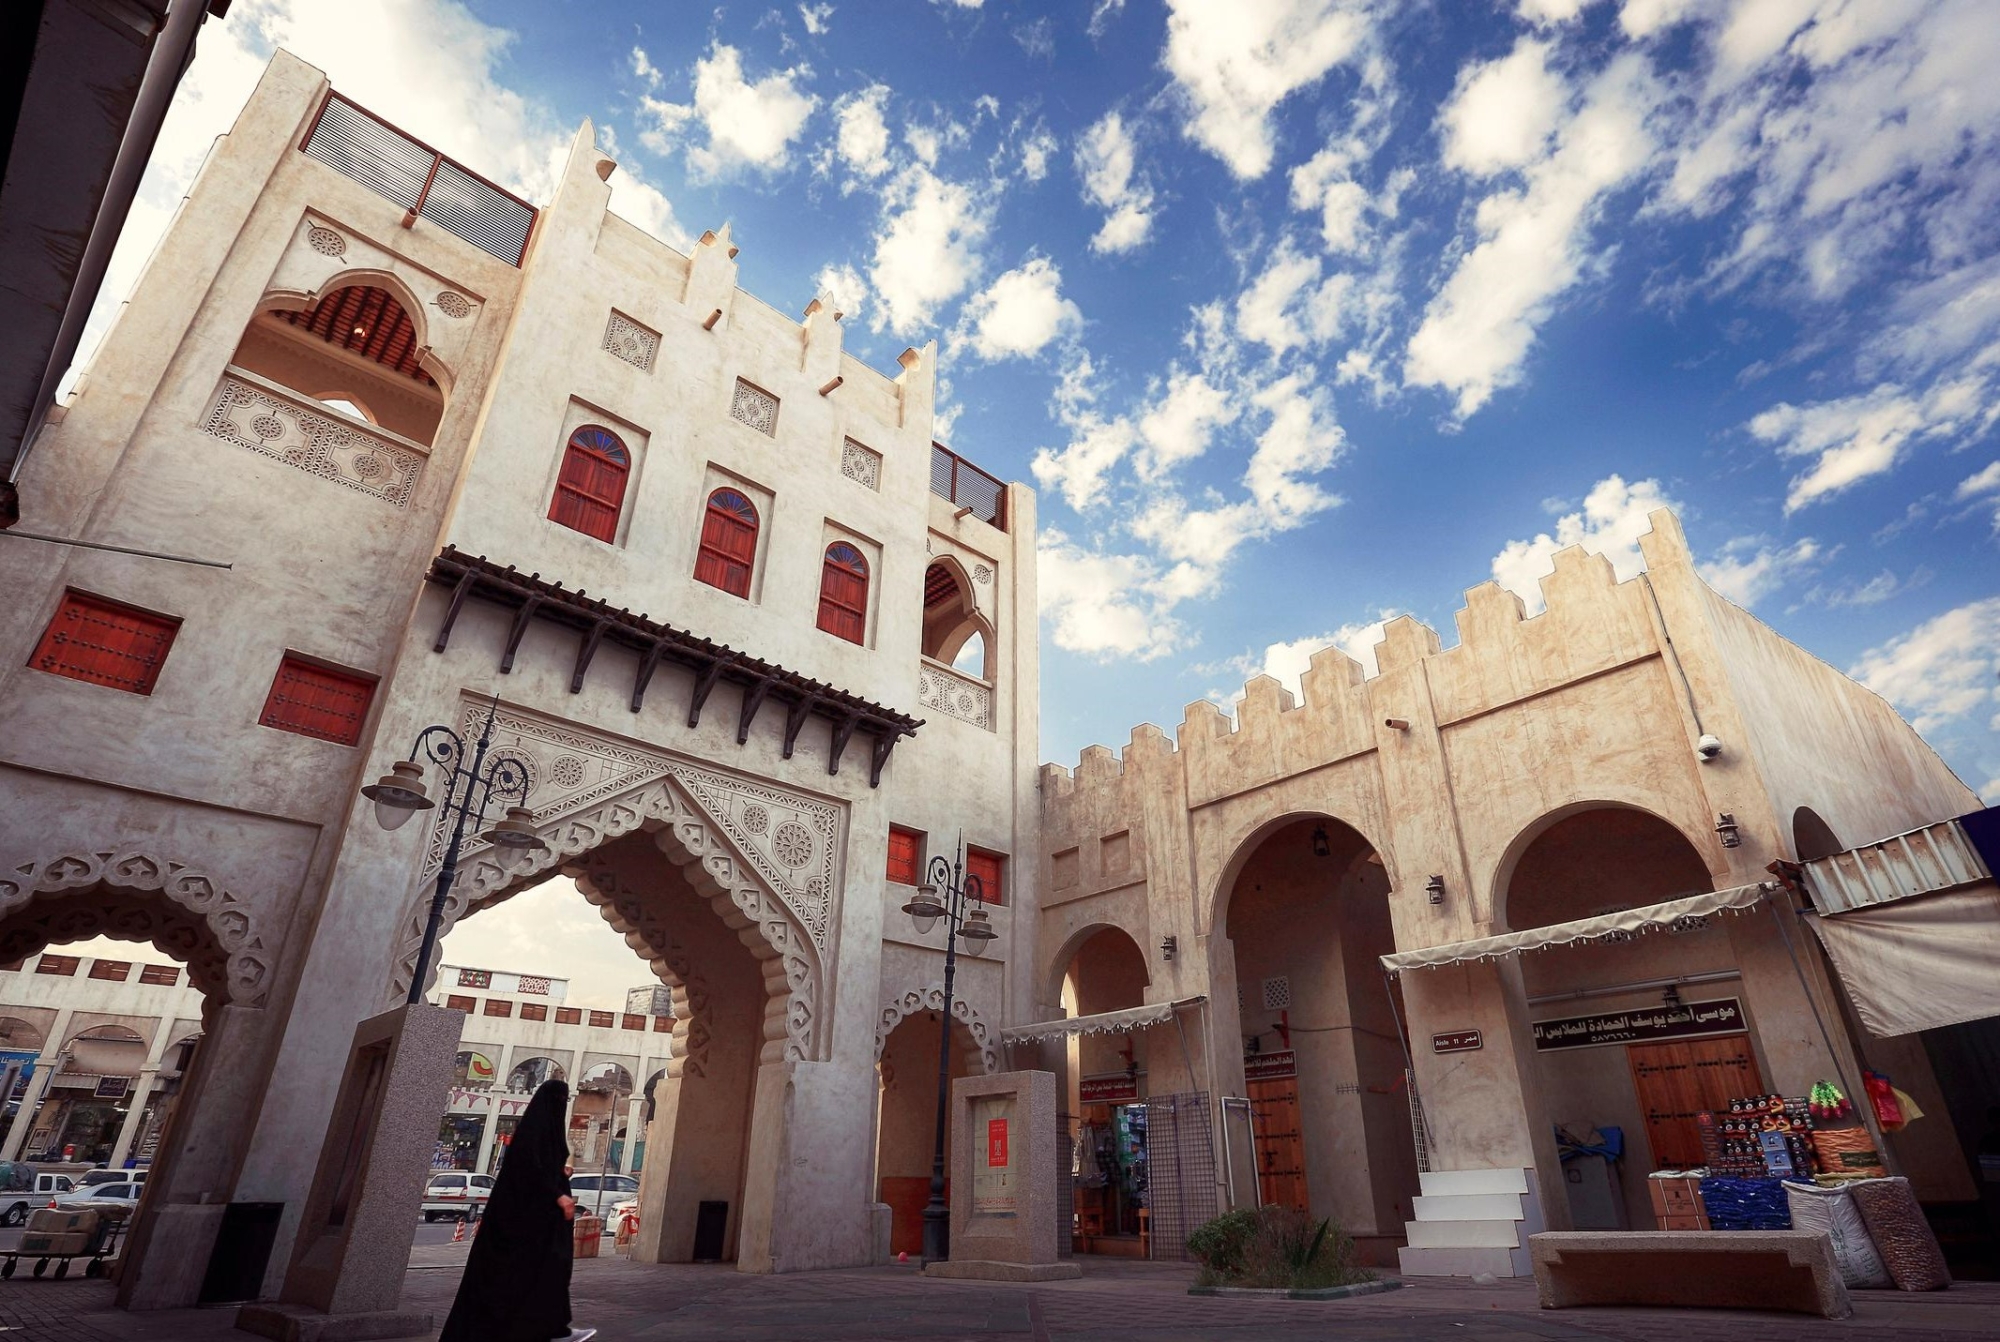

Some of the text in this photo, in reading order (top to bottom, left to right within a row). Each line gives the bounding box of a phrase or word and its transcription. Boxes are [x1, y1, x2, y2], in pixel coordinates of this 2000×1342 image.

[1632, 1013, 1667, 1028] يوسف
[1667, 1005, 1695, 1024] أحمد
[1696, 1006, 1735, 1022] موسى
[1546, 1022, 1588, 1040] للملابس
[1588, 1016, 1630, 1032] الحمادة
[1464, 1035, 1477, 1043] ممر
